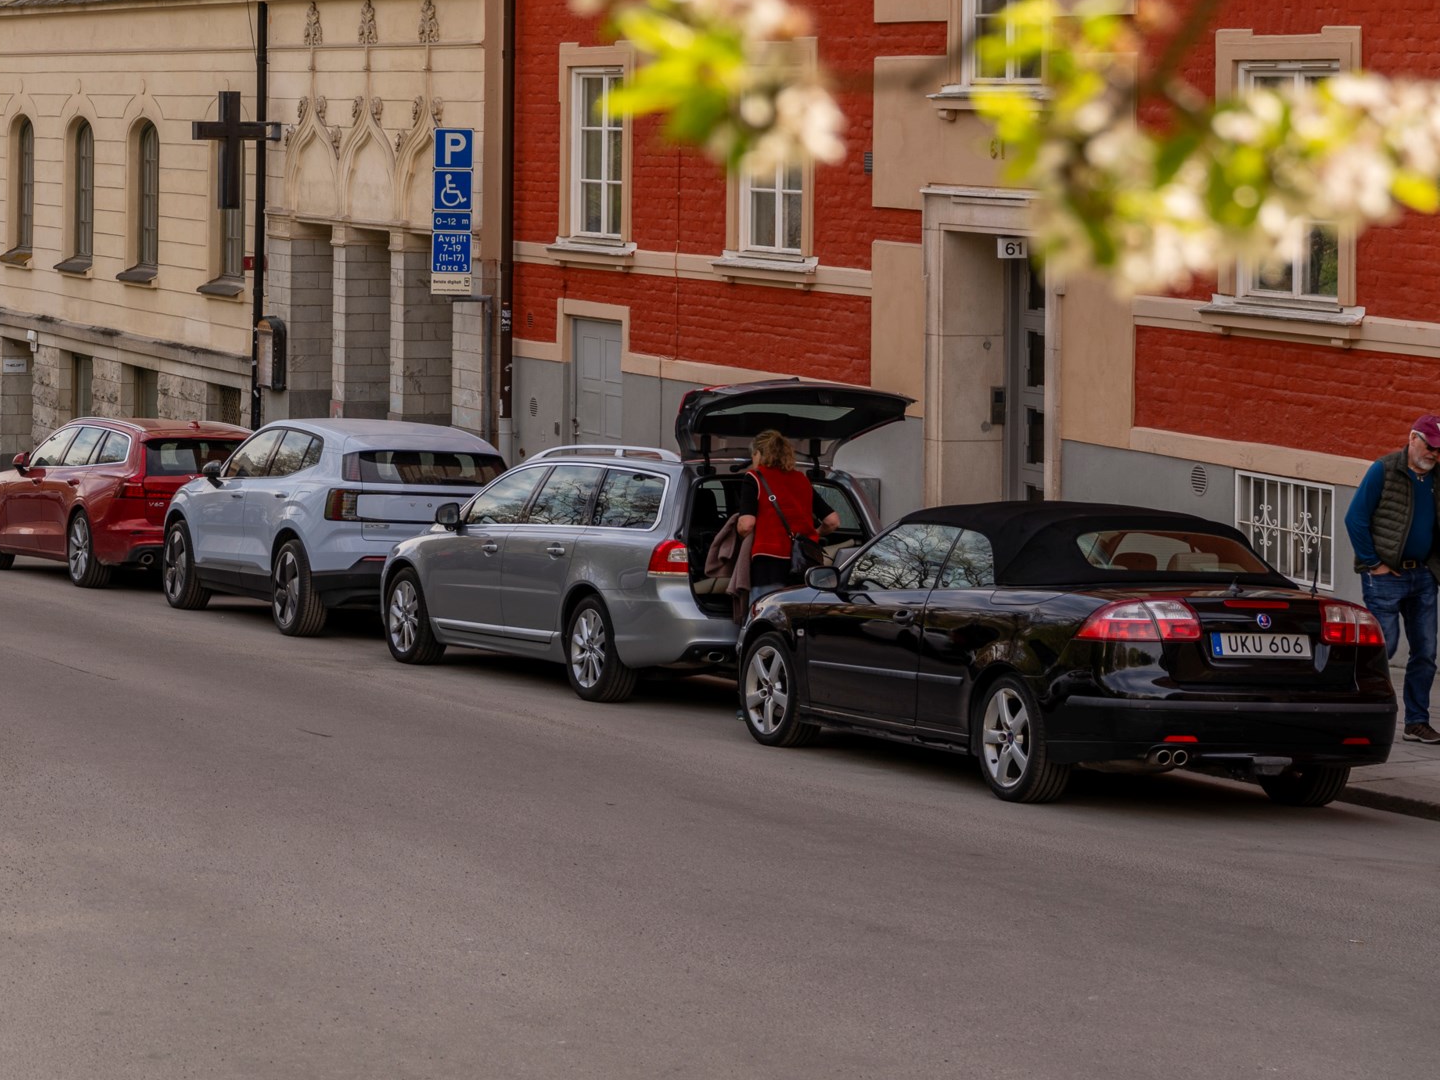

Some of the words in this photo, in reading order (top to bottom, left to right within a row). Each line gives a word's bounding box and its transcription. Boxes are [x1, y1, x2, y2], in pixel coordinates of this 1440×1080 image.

[444, 132, 467, 165] P
[435, 217, 457, 226] 0-12
[438, 234, 467, 244] Avgift
[443, 244, 462, 252] 7-19
[1005, 242, 1023, 256] 61
[438, 253, 465, 262] (11-17)
[436, 263, 459, 271] Taxa
[1227, 635, 1263, 653] UKU
[1269, 636, 1304, 654] 606
